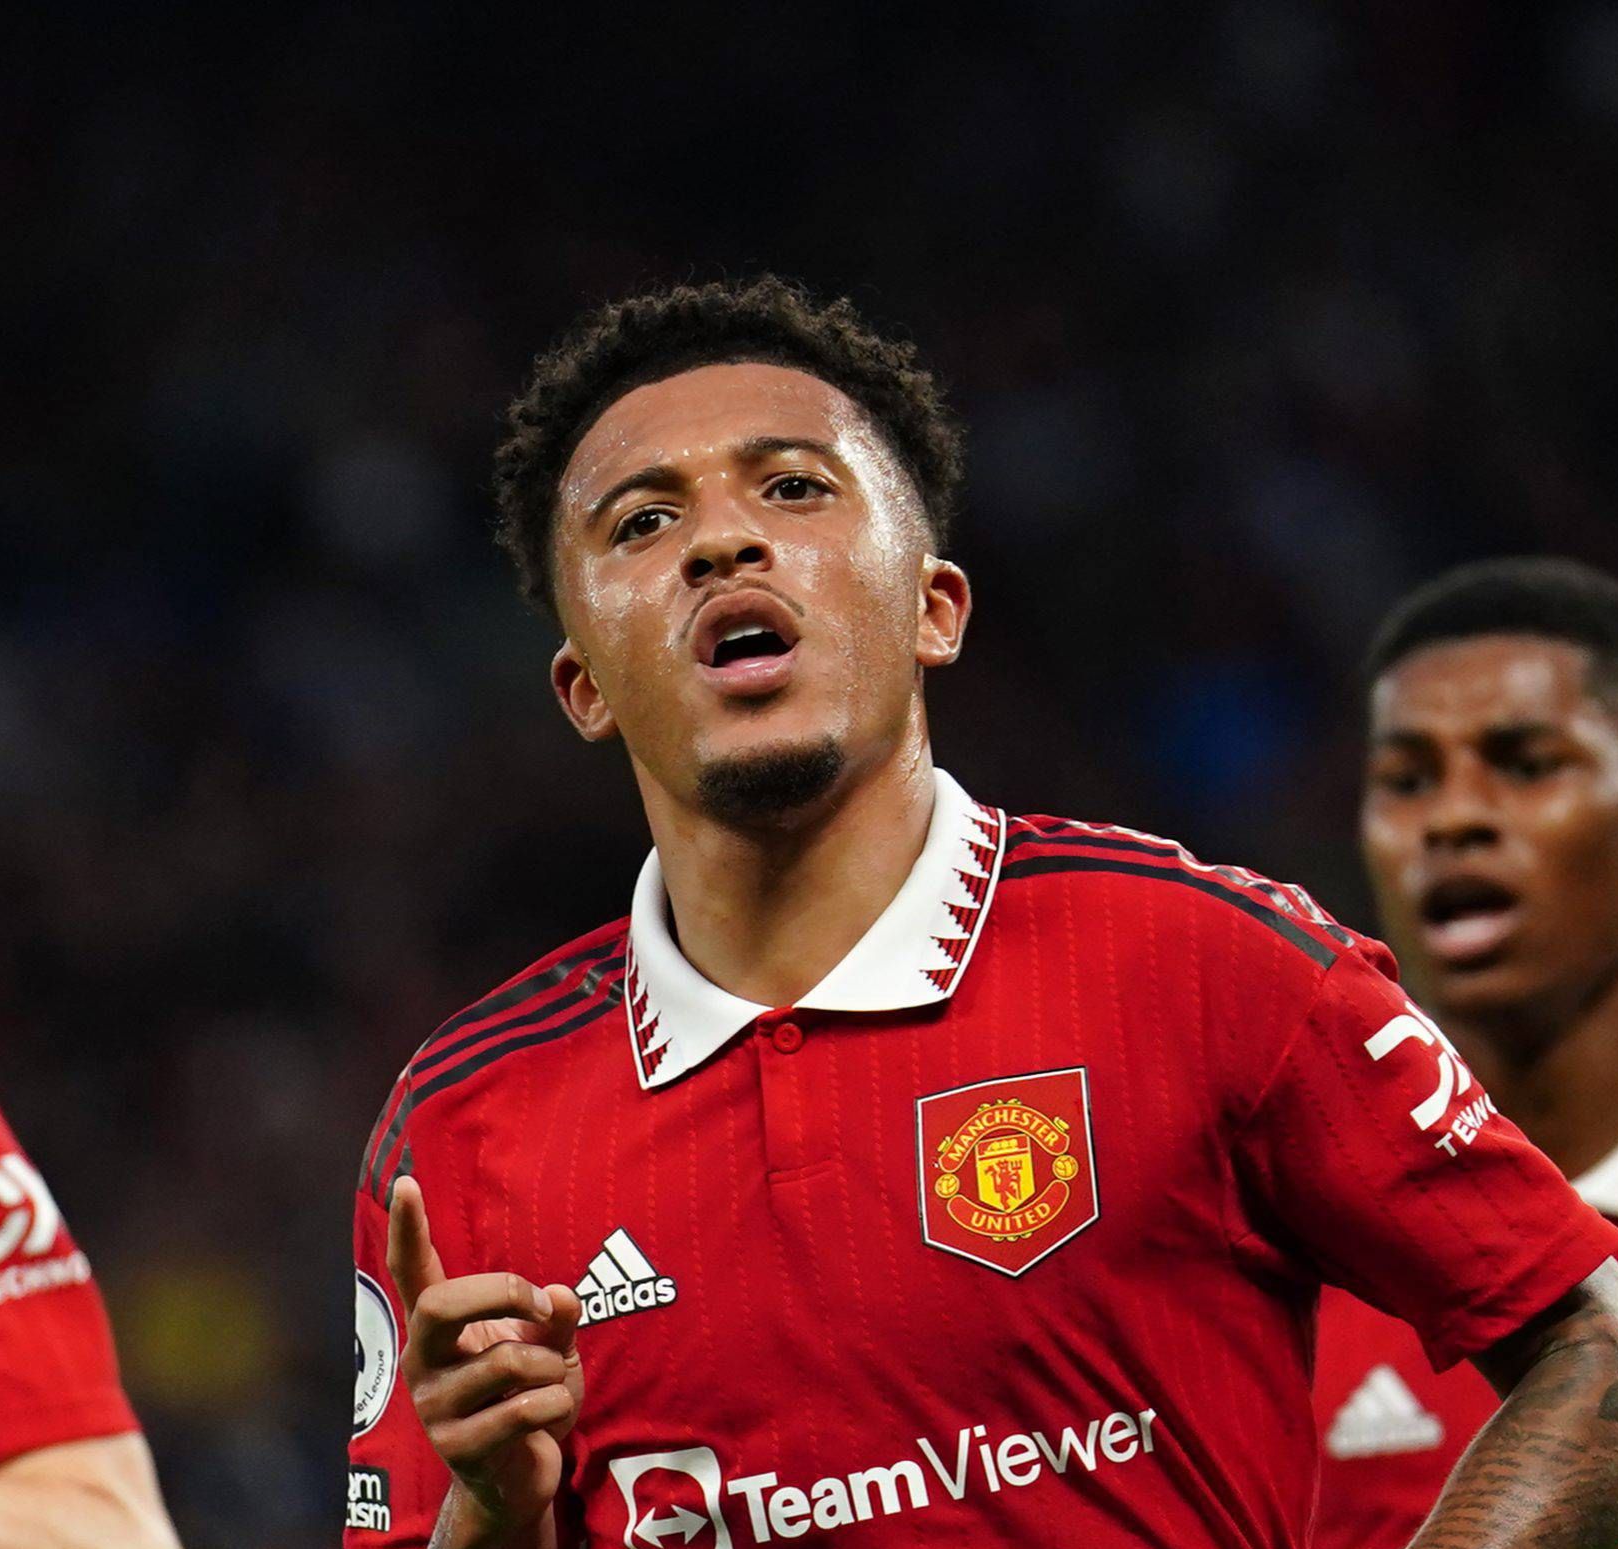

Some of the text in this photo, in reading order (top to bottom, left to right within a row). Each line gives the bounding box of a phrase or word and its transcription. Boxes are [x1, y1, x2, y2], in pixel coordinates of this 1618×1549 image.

[948, 1109, 1059, 1161] MANCHESTER
[971, 1203, 1051, 1231] UNITED
[727, 1408, 1156, 1543] TeamViewer
